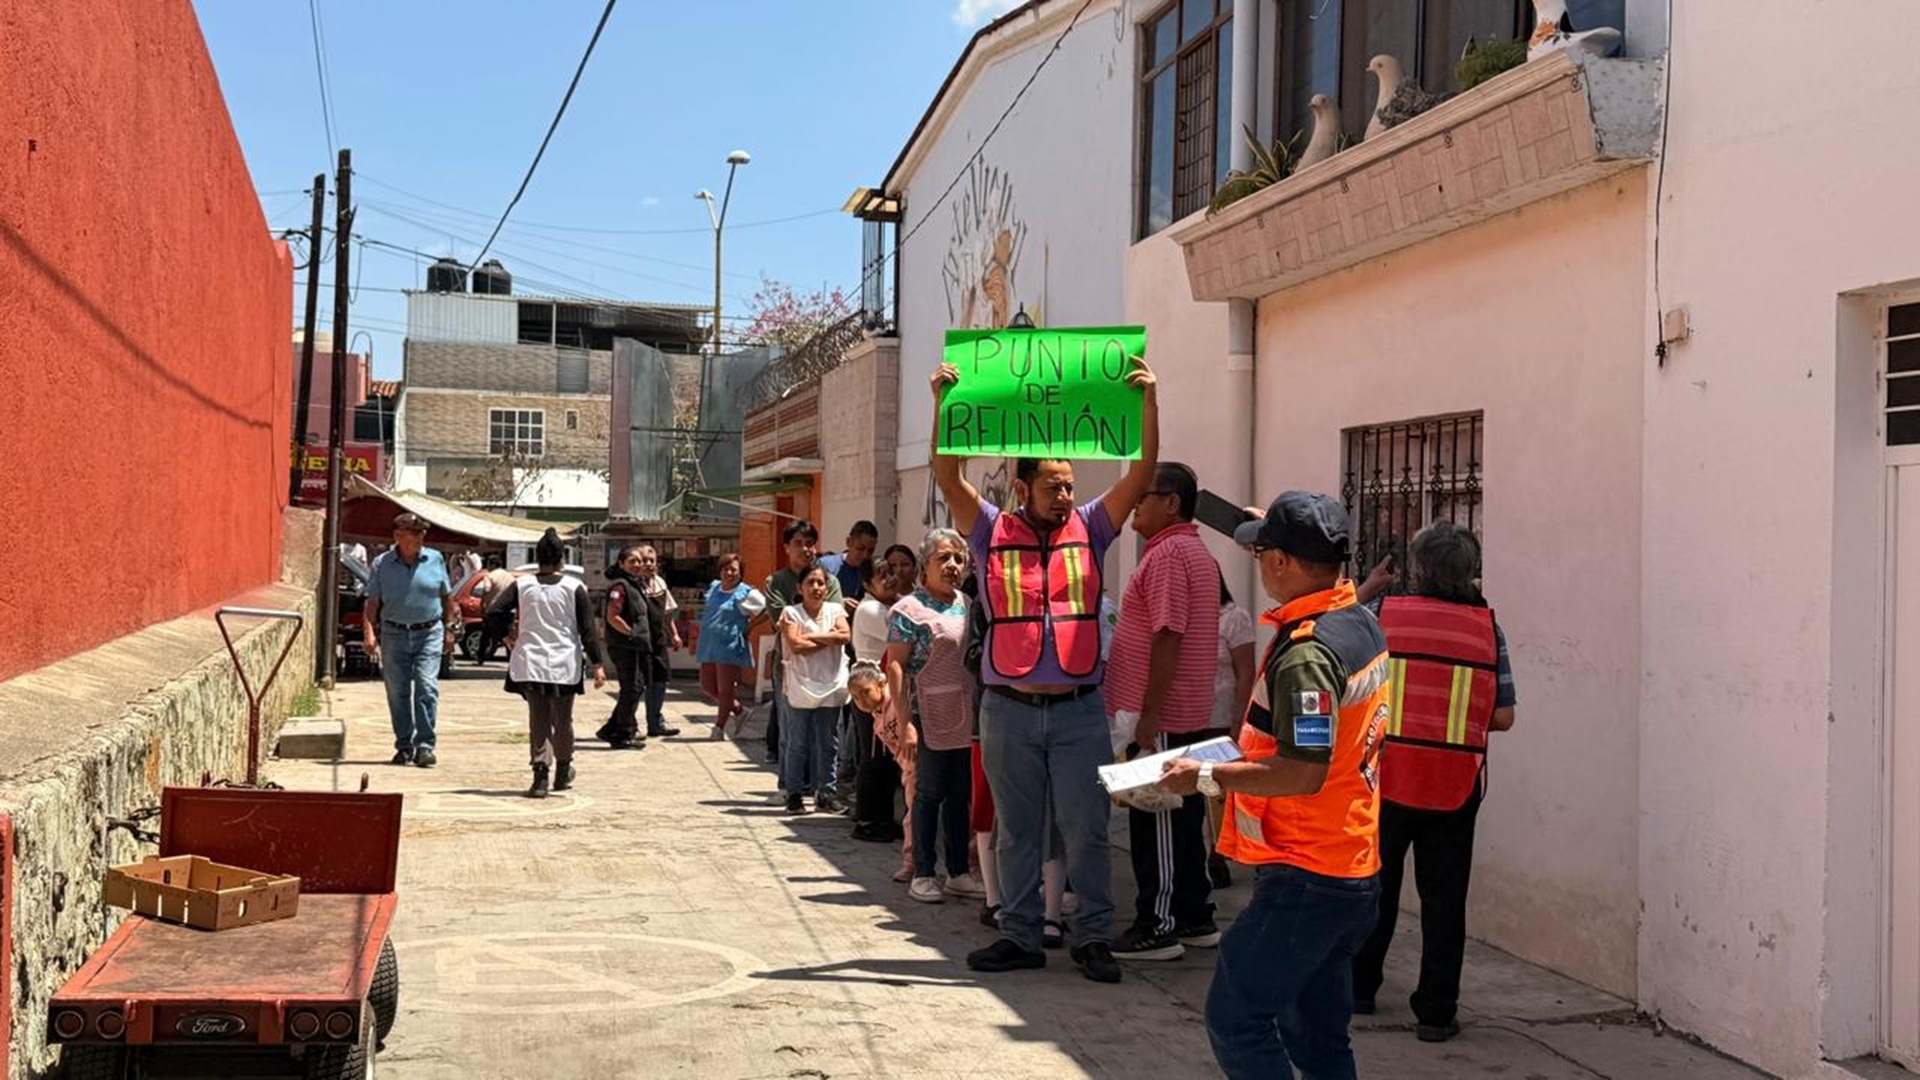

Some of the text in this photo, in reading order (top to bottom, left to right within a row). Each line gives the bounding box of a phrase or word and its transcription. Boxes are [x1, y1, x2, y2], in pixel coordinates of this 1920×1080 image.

[973, 333, 1126, 382] PUNTO
[1025, 382, 1061, 405] DE
[946, 401, 1127, 456] REUNIÓN
[191, 1017, 229, 1034] Ford
